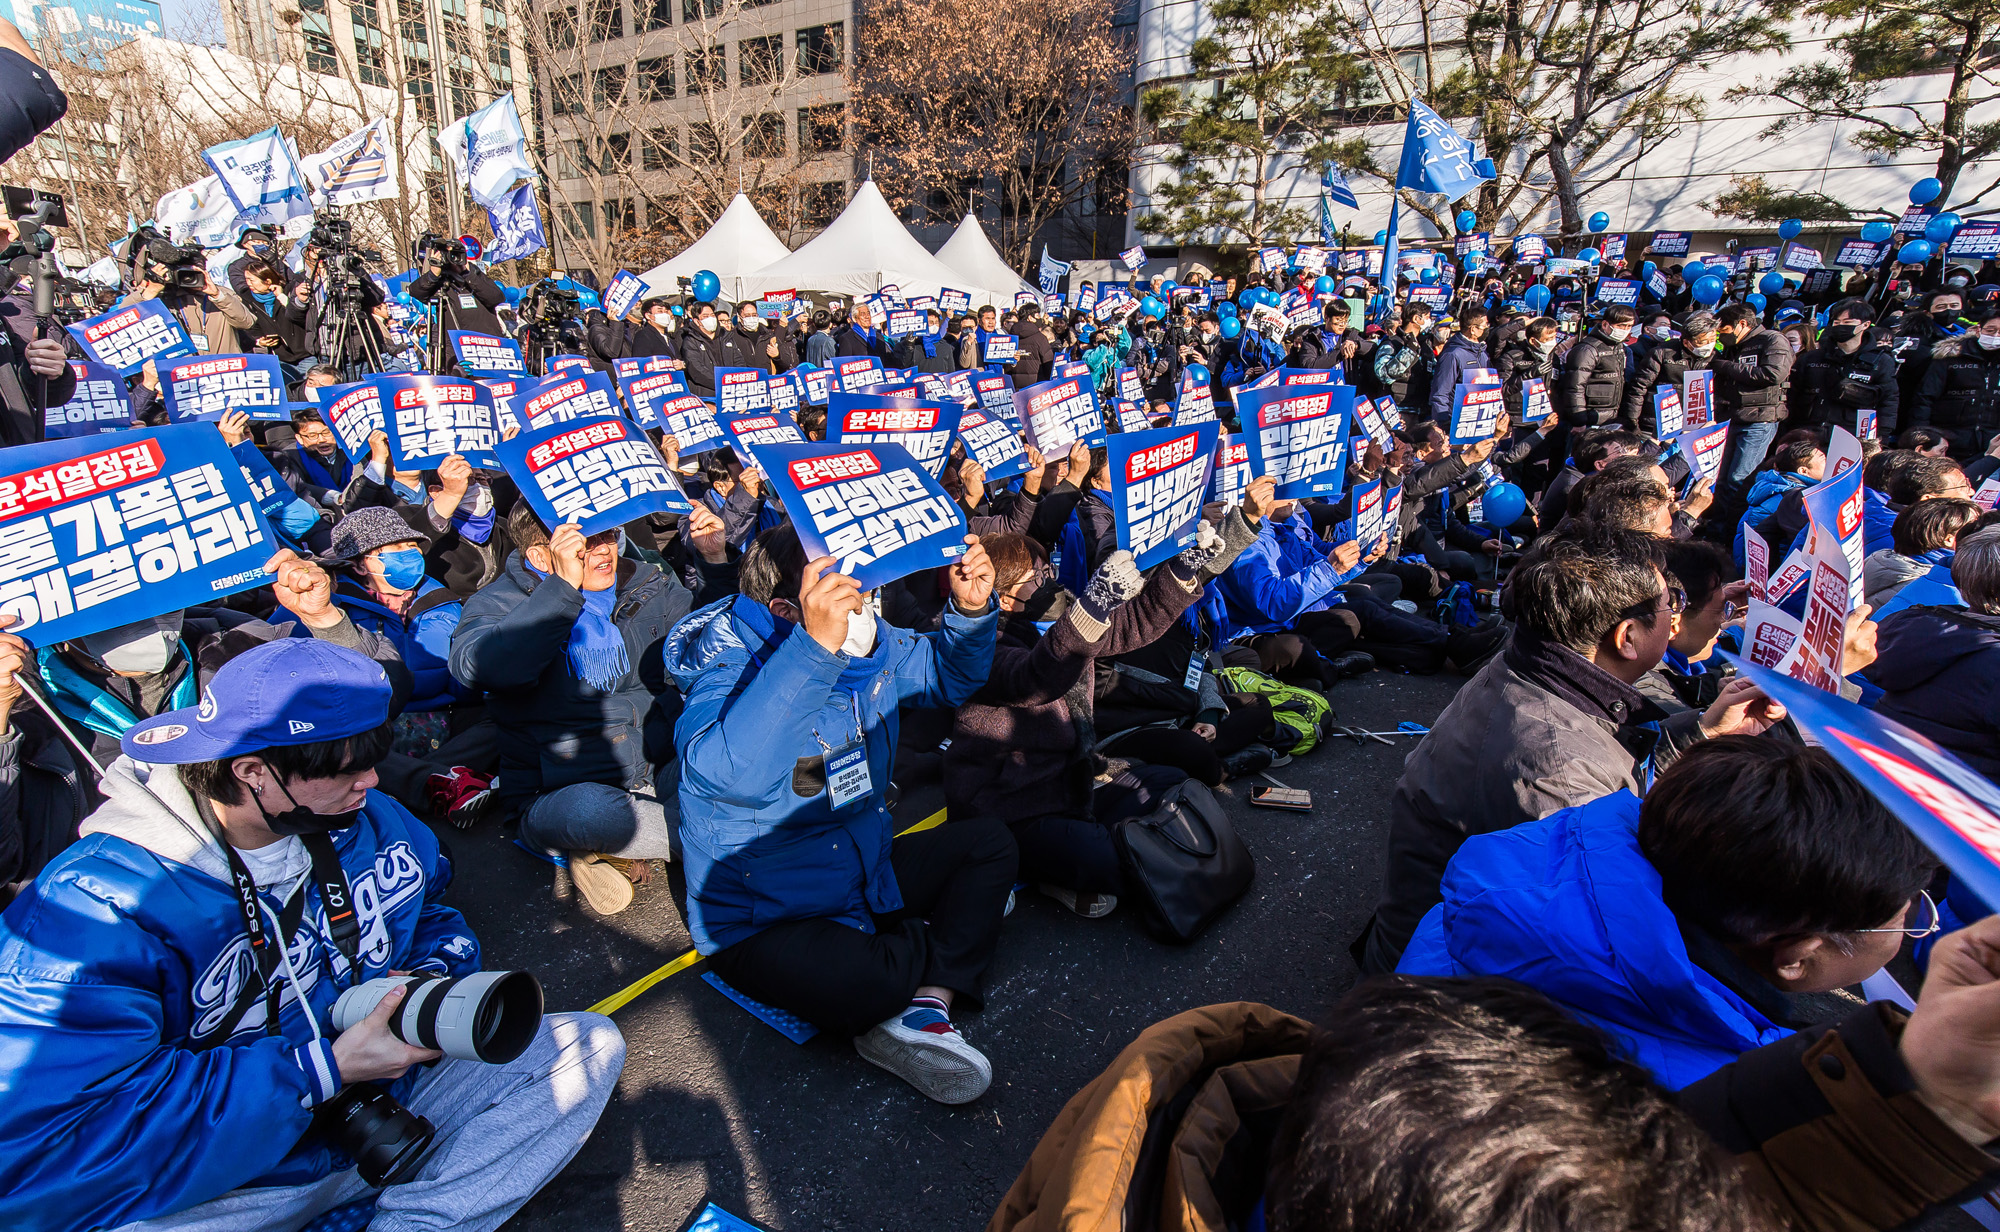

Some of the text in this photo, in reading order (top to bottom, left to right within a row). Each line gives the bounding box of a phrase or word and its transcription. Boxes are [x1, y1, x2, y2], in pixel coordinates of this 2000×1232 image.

[1652, 238, 1687, 246] 물가폭탄
[1841, 247, 1879, 257] 물가폭탄
[1951, 235, 2000, 245] 민생파탄
[1836, 255, 1876, 265] 해결하라!
[1599, 288, 1636, 296] 민생파탄
[87, 311, 140, 341] 윤석열정권
[91, 314, 168, 357] 민생파탄
[890, 316, 924, 327] 민생파탄
[102, 326, 183, 369] 못살겠다!
[461, 336, 500, 346] 윤석열정권
[461, 345, 516, 360] 민생파탄
[988, 342, 1016, 351] 물가폭탄
[175, 360, 243, 379] 윤석열정권
[724, 372, 757, 384] 윤석열정권
[841, 360, 872, 374] 윤석열정권
[841, 368, 885, 391] 민생파탄
[1288, 373, 1328, 385] 윤석열정권
[173, 370, 271, 400] 민생파탄
[400, 388, 473, 406] 윤석열정권
[527, 383, 586, 414] 윤석열정권
[631, 376, 672, 394] 윤석열정권
[721, 381, 767, 396] 민생파탄
[978, 378, 1004, 392] 윤석열정권
[980, 387, 1014, 406] 민생파탄
[1030, 383, 1079, 412] 윤석열정권
[176, 387, 281, 418] 못살겠다!
[335, 400, 381, 431] 민생파
[721, 394, 770, 414] 못살겠다!
[1030, 392, 1094, 432] 민생파탄
[1264, 395, 1330, 424] 윤석열정권
[1459, 400, 1505, 422] 물가폭
[396, 404, 491, 435] 민생파탄
[732, 418, 778, 434] 윤석열정권
[849, 410, 934, 430] 윤석열정권
[1036, 411, 1102, 456] 못살겠다!
[400, 428, 498, 460] 못살겠다!
[530, 423, 623, 467] 윤석열정권
[961, 420, 1011, 450] 민생파탄
[1259, 413, 1342, 459] 민생파탄
[974, 433, 1024, 473] 못살겠다!
[1130, 435, 1194, 479] 윤석열정권
[1264, 442, 1343, 487] 못살겠다!
[533, 441, 661, 501] 민생파탄
[793, 453, 879, 486] 윤석열정권
[801, 467, 930, 534] 민생파탄
[1126, 453, 1209, 523] 민생파탄
[0, 463, 231, 584] 물가폭탄
[824, 495, 960, 575] 못살겠다!
[1129, 485, 1205, 558] 못살겠다!
[0, 501, 263, 633] 해결하라!
[829, 750, 861, 771] 더불어민주당
[236, 872, 260, 933] SONY
